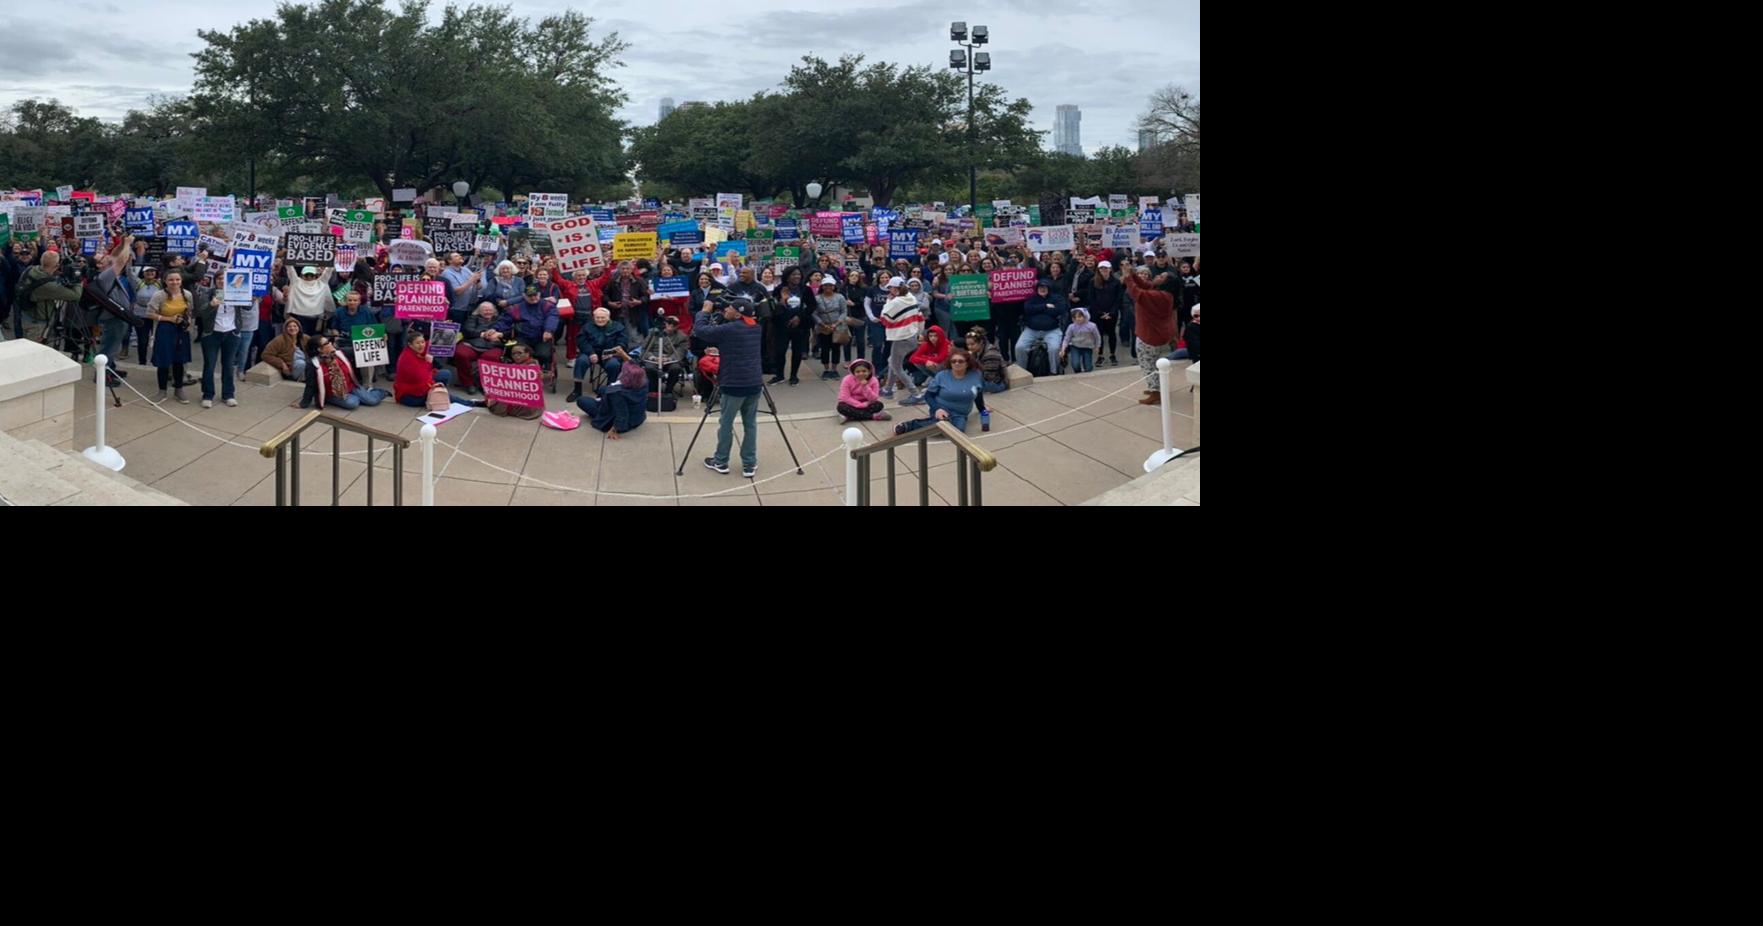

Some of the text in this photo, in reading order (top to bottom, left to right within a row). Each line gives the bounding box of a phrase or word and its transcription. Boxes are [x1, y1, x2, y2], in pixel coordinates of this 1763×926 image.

[126, 209, 151, 221] MY
[281, 218, 304, 226] DEFEND
[345, 222, 370, 230] DEFEND
[551, 218, 590, 231] GOD
[167, 225, 194, 235] MY
[350, 231, 363, 239] LIFE
[236, 233, 247, 241] By
[288, 234, 324, 242] PRO-LIFE
[565, 232, 583, 243] IS
[892, 232, 916, 240] MY
[288, 241, 334, 250] EVIDENCE
[435, 243, 473, 252] BASED
[558, 244, 596, 257] PRO
[236, 254, 269, 267] MY
[287, 250, 333, 261] BASED
[562, 256, 600, 270] LIFE
[994, 271, 1034, 281] DEFUND
[374, 282, 396, 290] EVID
[400, 284, 443, 294] DEFUND
[994, 281, 1033, 290] PLANNED
[993, 289, 1033, 297] PARENTHOOD
[399, 296, 445, 305] PLANNED
[355, 340, 385, 351] DEFEND
[364, 352, 381, 362] LIFE
[481, 364, 537, 380] DEFUND
[484, 376, 539, 392] PLANNED
[485, 387, 540, 401] PARENTHOOD
